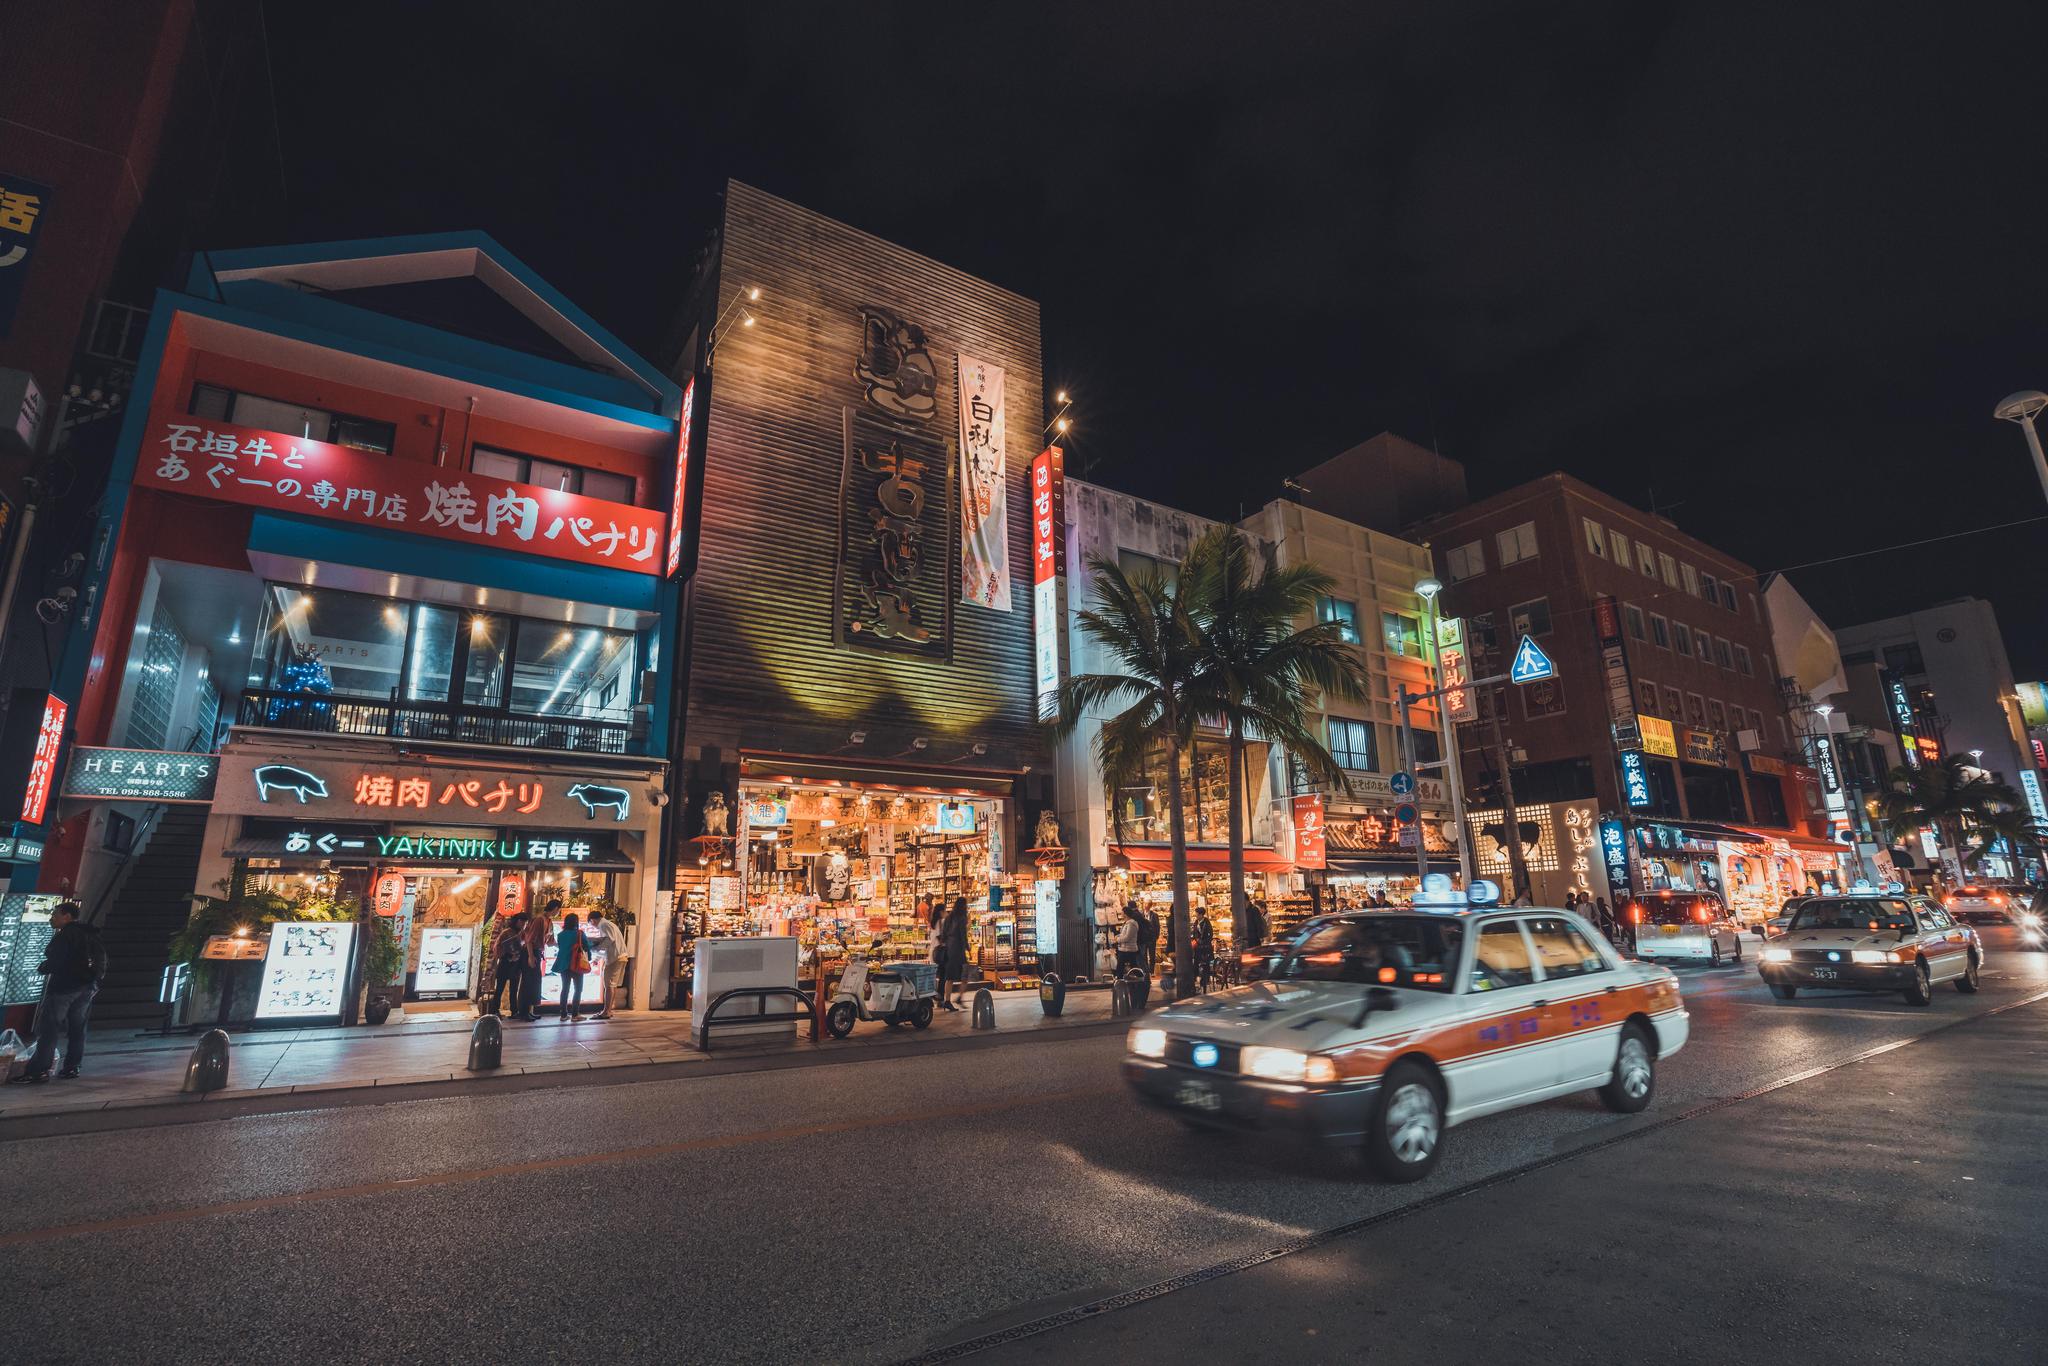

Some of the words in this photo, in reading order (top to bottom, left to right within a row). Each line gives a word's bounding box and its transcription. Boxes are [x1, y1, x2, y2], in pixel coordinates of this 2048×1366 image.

[160, 423, 303, 469] 石垣牛と
[156, 453, 408, 523] あぐーの専門店
[419, 480, 658, 562] 焼肉パナリ
[84, 758, 209, 778] HEARTS
[99, 787, 119, 795] TEL
[121, 788, 186, 798] 098-868-5586
[354, 774, 543, 814] 焼肉パナリ
[18, 844, 42, 858] HEARTS
[285, 831, 365, 855] あぐー
[377, 834, 520, 859] YAKINIKU
[527, 840, 591, 862] 石垣牛
